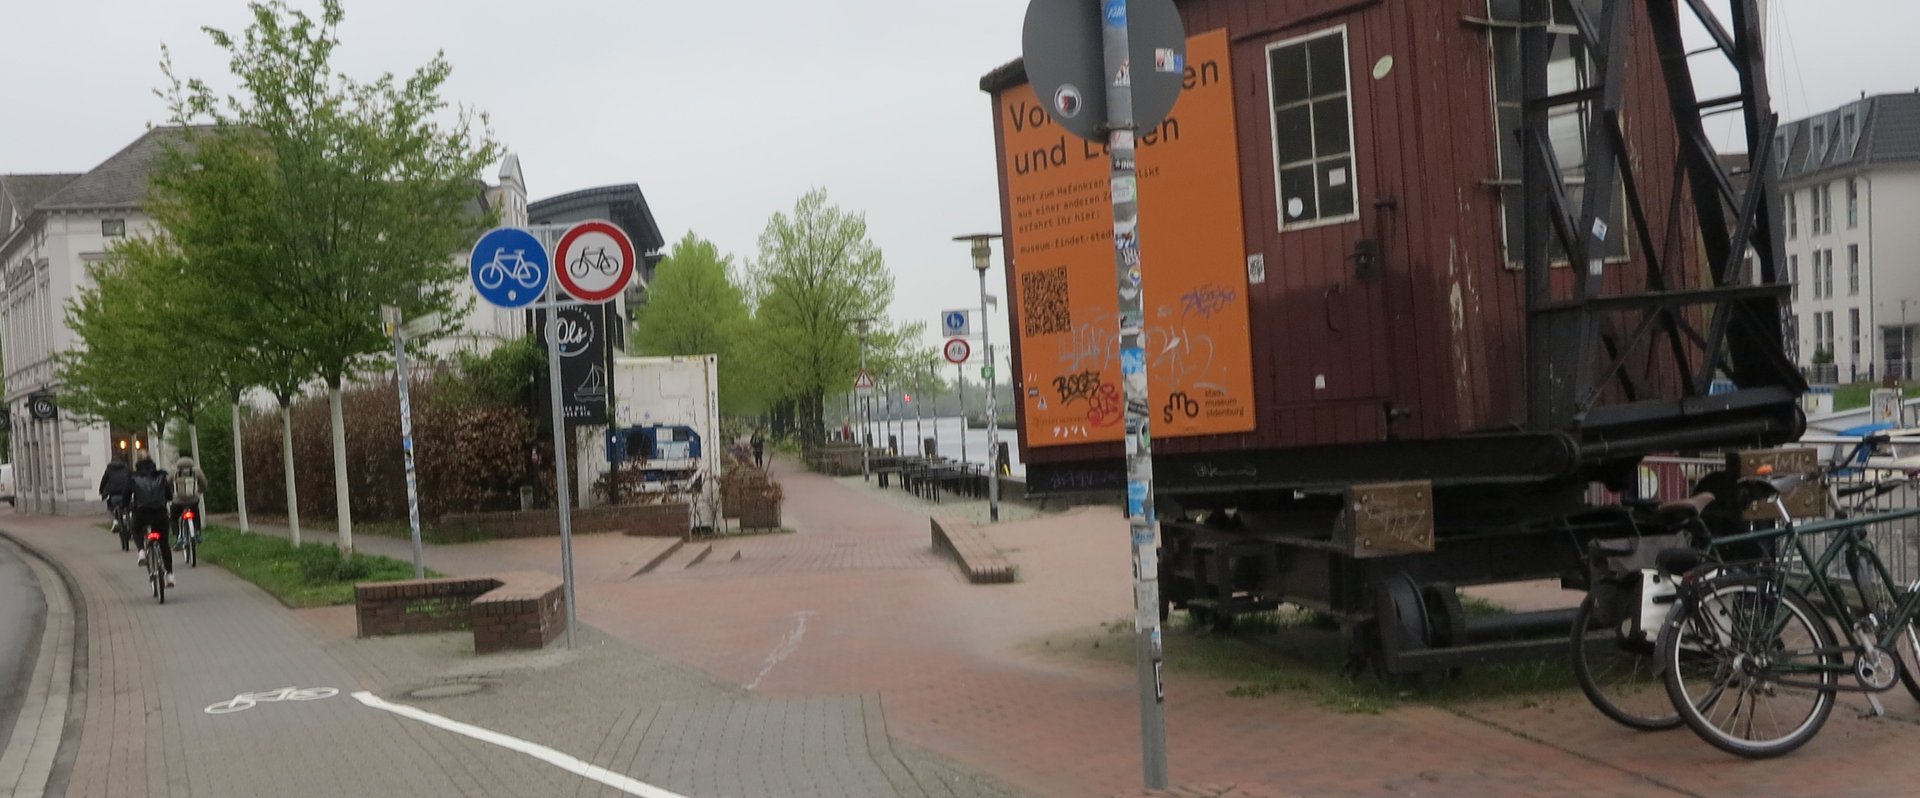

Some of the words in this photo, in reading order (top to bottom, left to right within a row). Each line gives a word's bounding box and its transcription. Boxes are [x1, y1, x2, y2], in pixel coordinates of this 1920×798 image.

[1009, 102, 1051, 133] Vo
[1015, 136, 1067, 175] und
[1017, 194, 1036, 205] Mehr
[1040, 190, 1055, 201] zum
[1057, 179, 1104, 198] Hafenkran
[1036, 203, 1060, 216] einer
[1063, 194, 1100, 210] anderen
[1019, 219, 1053, 233] erfahrt
[1205, 397, 1238, 408] museum
[1206, 406, 1245, 418] oldenburg
